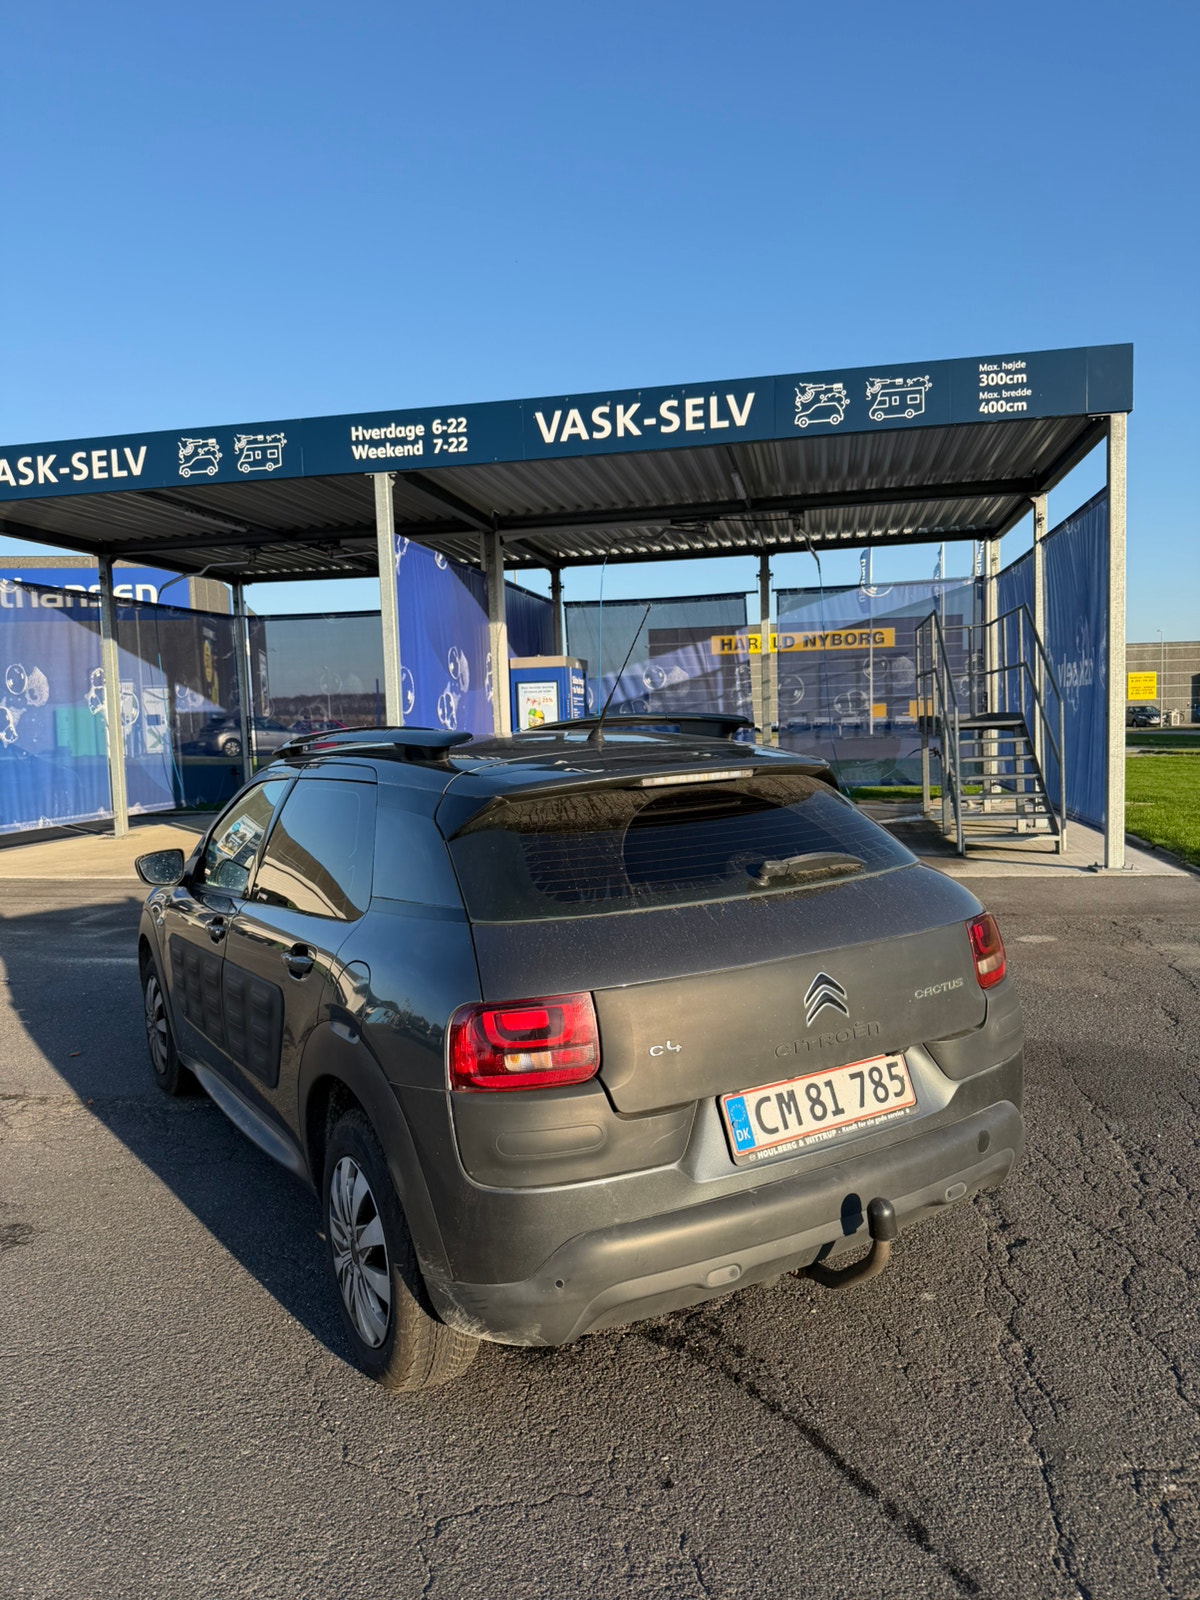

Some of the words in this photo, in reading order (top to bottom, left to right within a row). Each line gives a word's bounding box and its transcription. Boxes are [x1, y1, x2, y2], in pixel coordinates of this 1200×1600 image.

[979, 363, 1000, 372] Max.
[1002, 360, 1027, 371] højde
[979, 372, 1027, 387] 300cm
[979, 391, 1000, 400] Max.
[1002, 388, 1032, 398] bredde
[979, 400, 1027, 414] 400cm
[535, 392, 756, 444] VASK-SELV
[351, 423, 425, 441] Hverdage
[432, 417, 467, 434] 6-22
[351, 440, 424, 460] Weekend
[433, 437, 468, 454] 7-22
[0, 446, 147, 487] ASK-SELV
[720, 635, 795, 652] HARLD
[803, 631, 886, 648] NYBORG
[914, 978, 964, 999] CACTUS
[649, 1040, 683, 1057] C4
[775, 1021, 880, 1057] CITROËN
[755, 1089, 803, 1135] CM
[805, 1079, 845, 1122] 81
[848, 1061, 906, 1109] 785
[736, 1127, 751, 1142] DK
[757, 1140, 797, 1160] HOULBERG
[798, 1138, 805, 1147] &
[805, 1130, 837, 1145] WITTRUP
